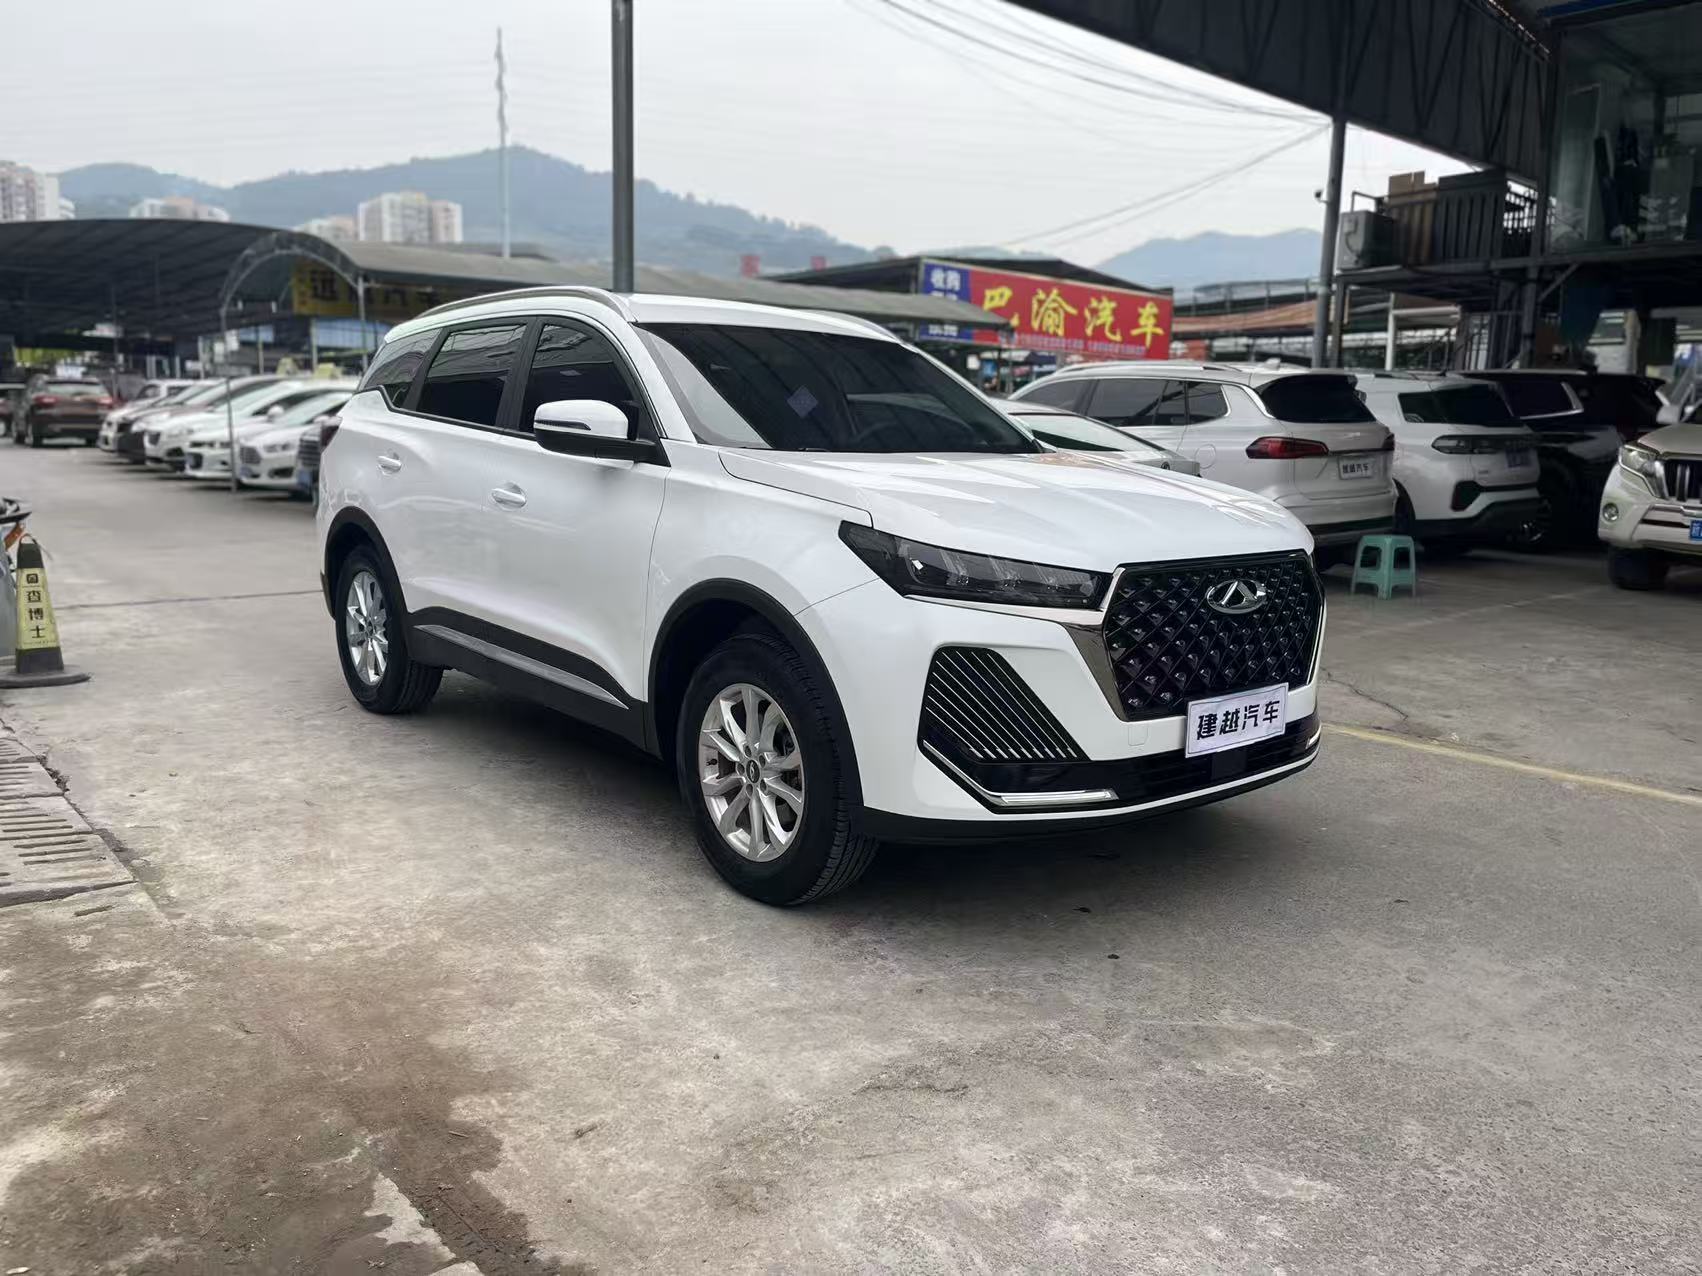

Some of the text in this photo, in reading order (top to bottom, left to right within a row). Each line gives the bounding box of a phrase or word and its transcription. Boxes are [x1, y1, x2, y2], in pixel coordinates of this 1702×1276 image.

[983, 285, 1165, 350] 巴渝汽车
[1196, 700, 1280, 741] 建越汽车
